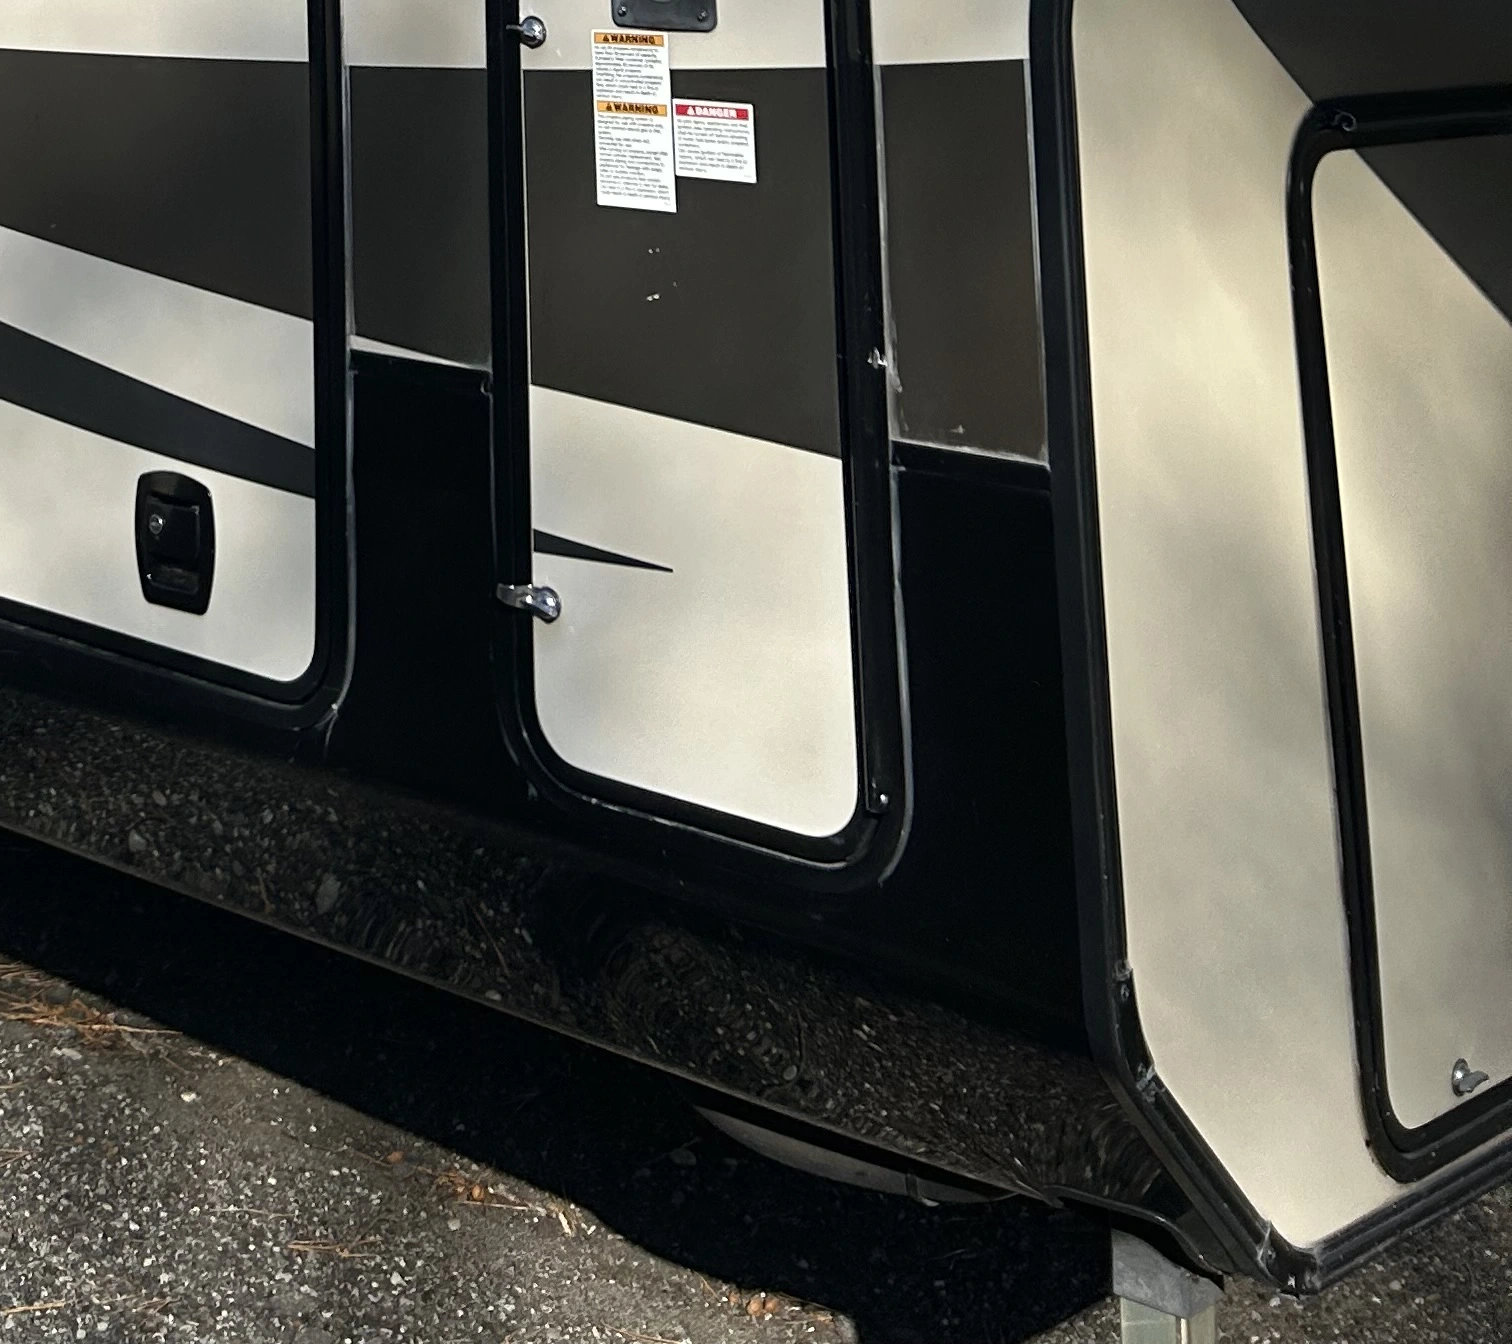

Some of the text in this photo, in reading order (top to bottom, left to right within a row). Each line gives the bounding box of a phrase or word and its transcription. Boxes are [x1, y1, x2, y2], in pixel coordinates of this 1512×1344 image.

[611, 33, 655, 44] WARNING
[614, 102, 659, 114] WARNING
[695, 106, 738, 119] DANGER
